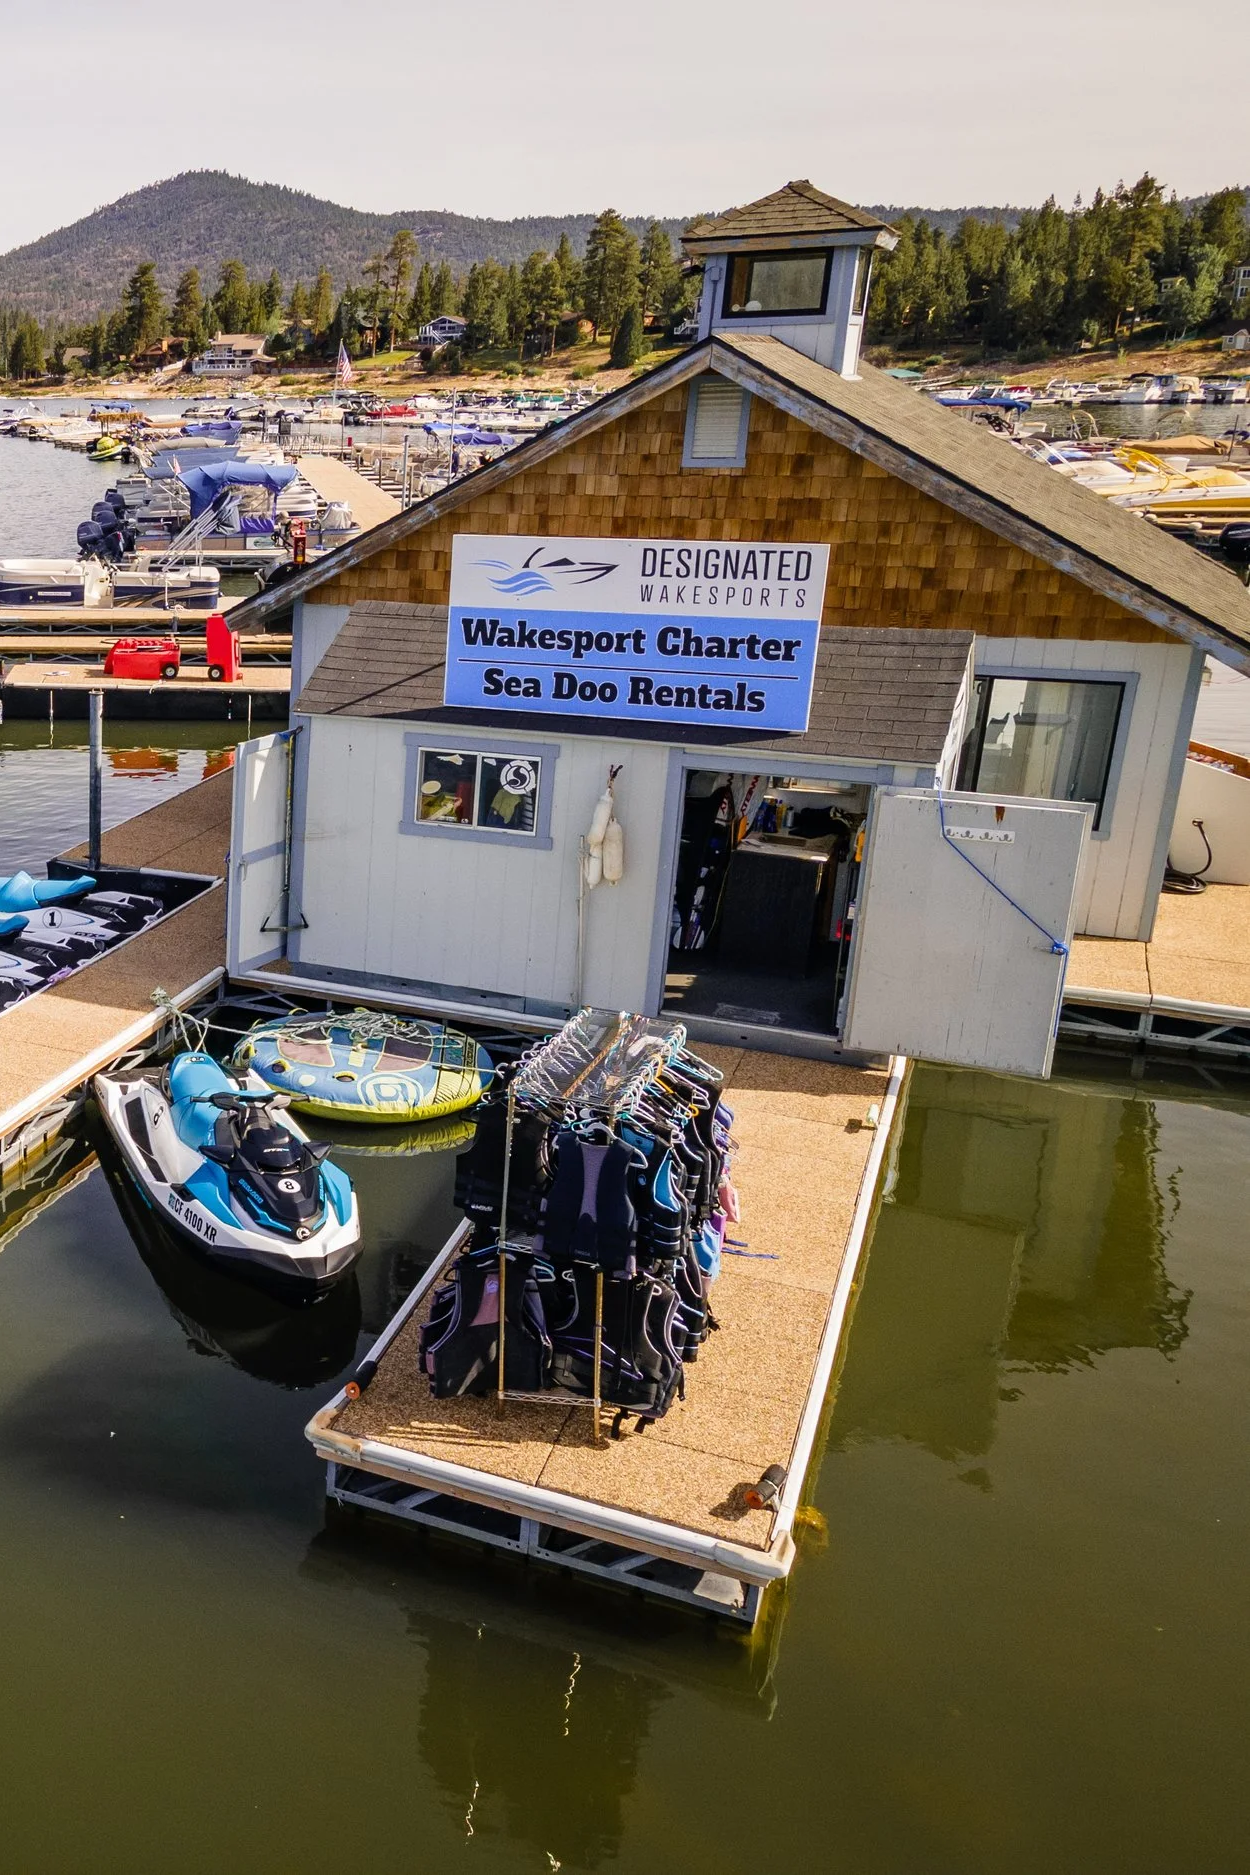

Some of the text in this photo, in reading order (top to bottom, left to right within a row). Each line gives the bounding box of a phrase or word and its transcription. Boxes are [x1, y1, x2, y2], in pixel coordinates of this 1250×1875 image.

[639, 546, 813, 583] DESIGNATED
[639, 584, 808, 609] WAKESPORTS
[461, 616, 803, 663] Wakesport Charter
[481, 666, 766, 714] Sea Doo Rentals
[49, 911, 57, 927] 1
[284, 1180, 295, 1190] 8
[174, 1197, 185, 1216] CF
[183, 1207, 203, 1233] 4100
[205, 1222, 218, 1243] XR
